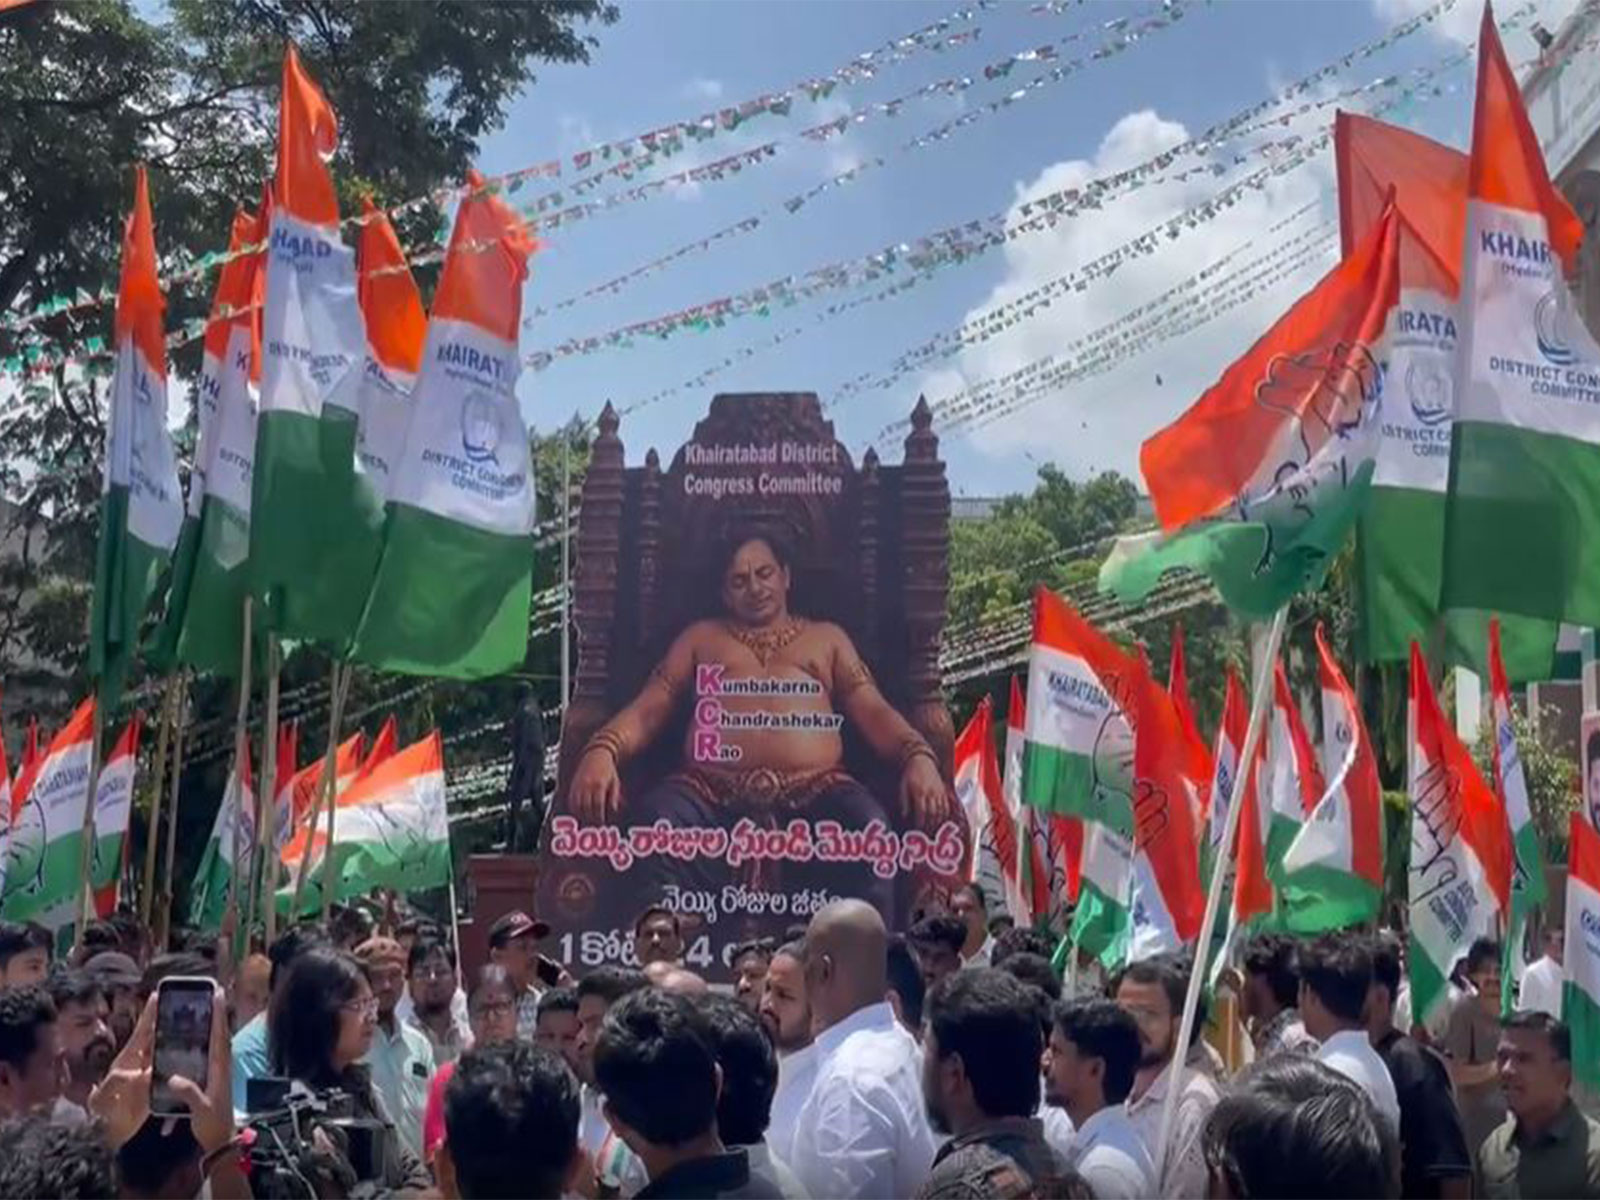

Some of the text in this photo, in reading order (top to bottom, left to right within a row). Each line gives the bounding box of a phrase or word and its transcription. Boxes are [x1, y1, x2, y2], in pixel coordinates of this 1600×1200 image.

[1489, 355, 1561, 382] DISTRICT
[684, 442, 839, 465] Khairatabad District
[684, 472, 843, 500] Congress Committee
[697, 665, 823, 696] Kumbakarna
[696, 698, 844, 729] Chandrashekar
[695, 730, 742, 760] Rao
[629, 819, 728, 861] రోజుల
